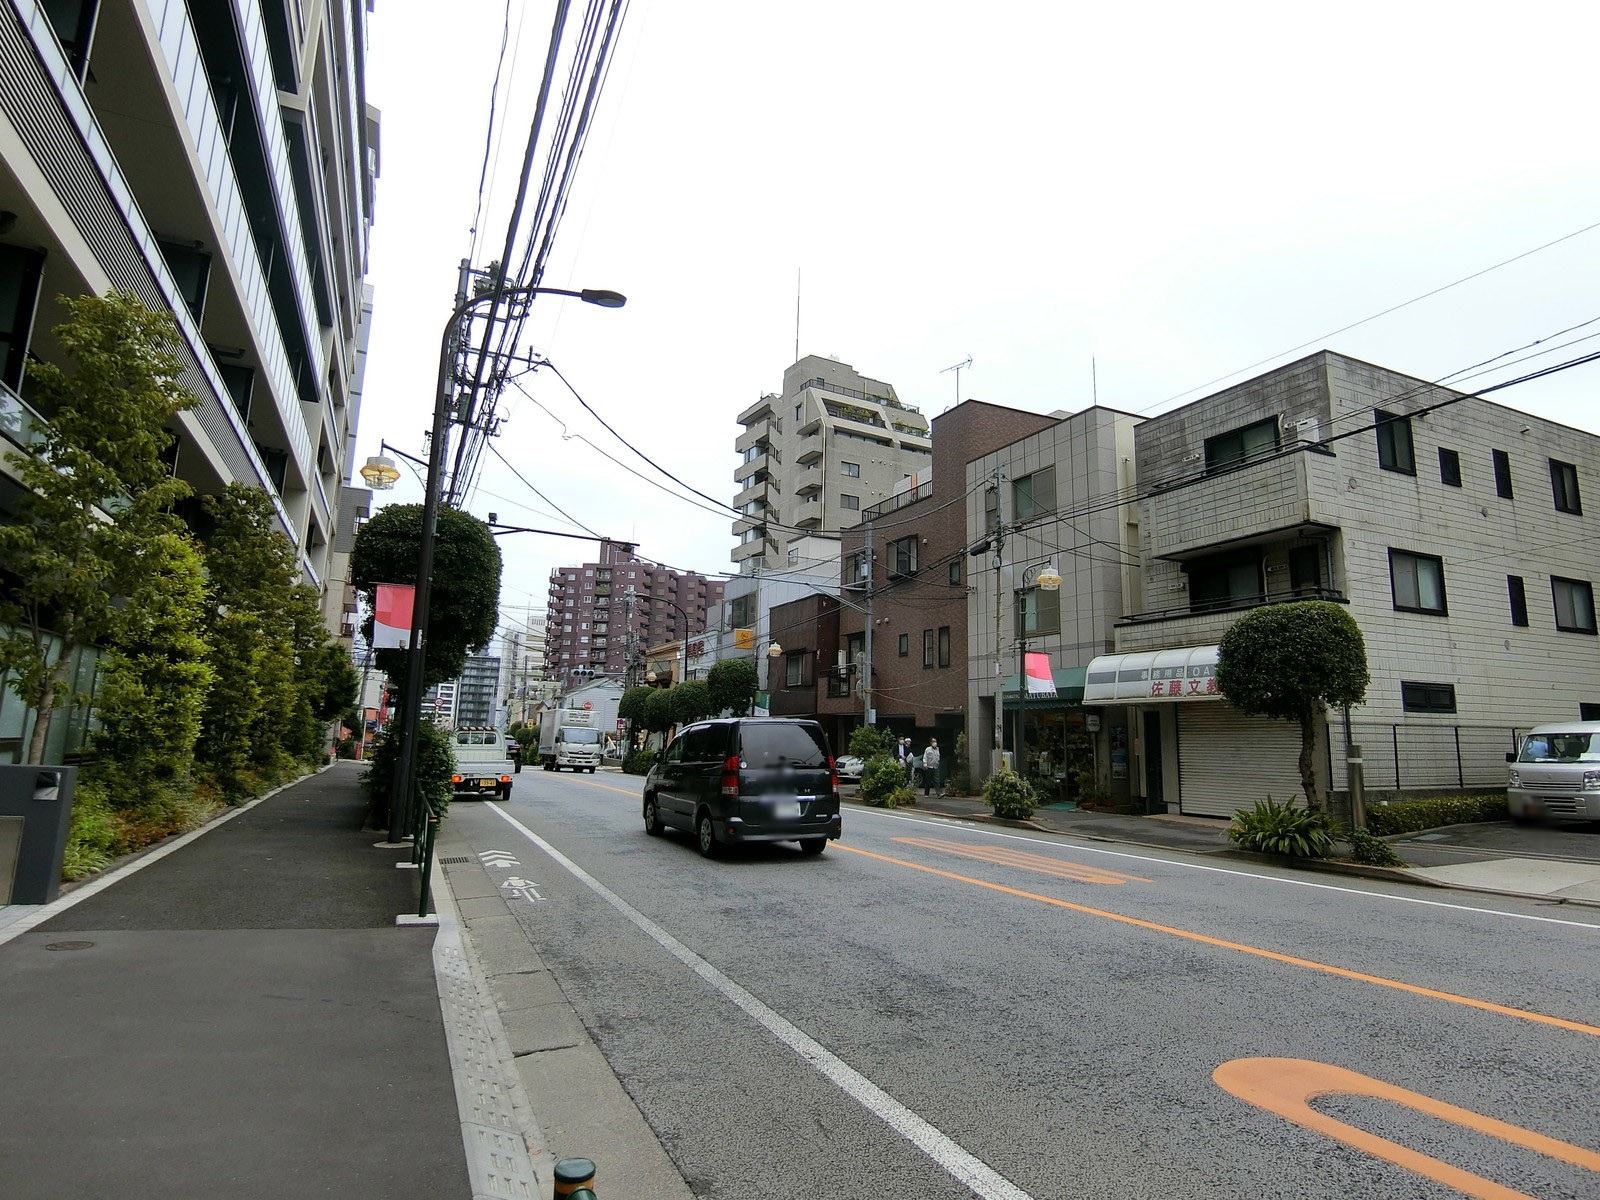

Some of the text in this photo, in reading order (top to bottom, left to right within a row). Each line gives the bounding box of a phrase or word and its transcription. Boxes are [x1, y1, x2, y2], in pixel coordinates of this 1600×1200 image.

[1141, 666, 1218, 680] 事務用品・OA
